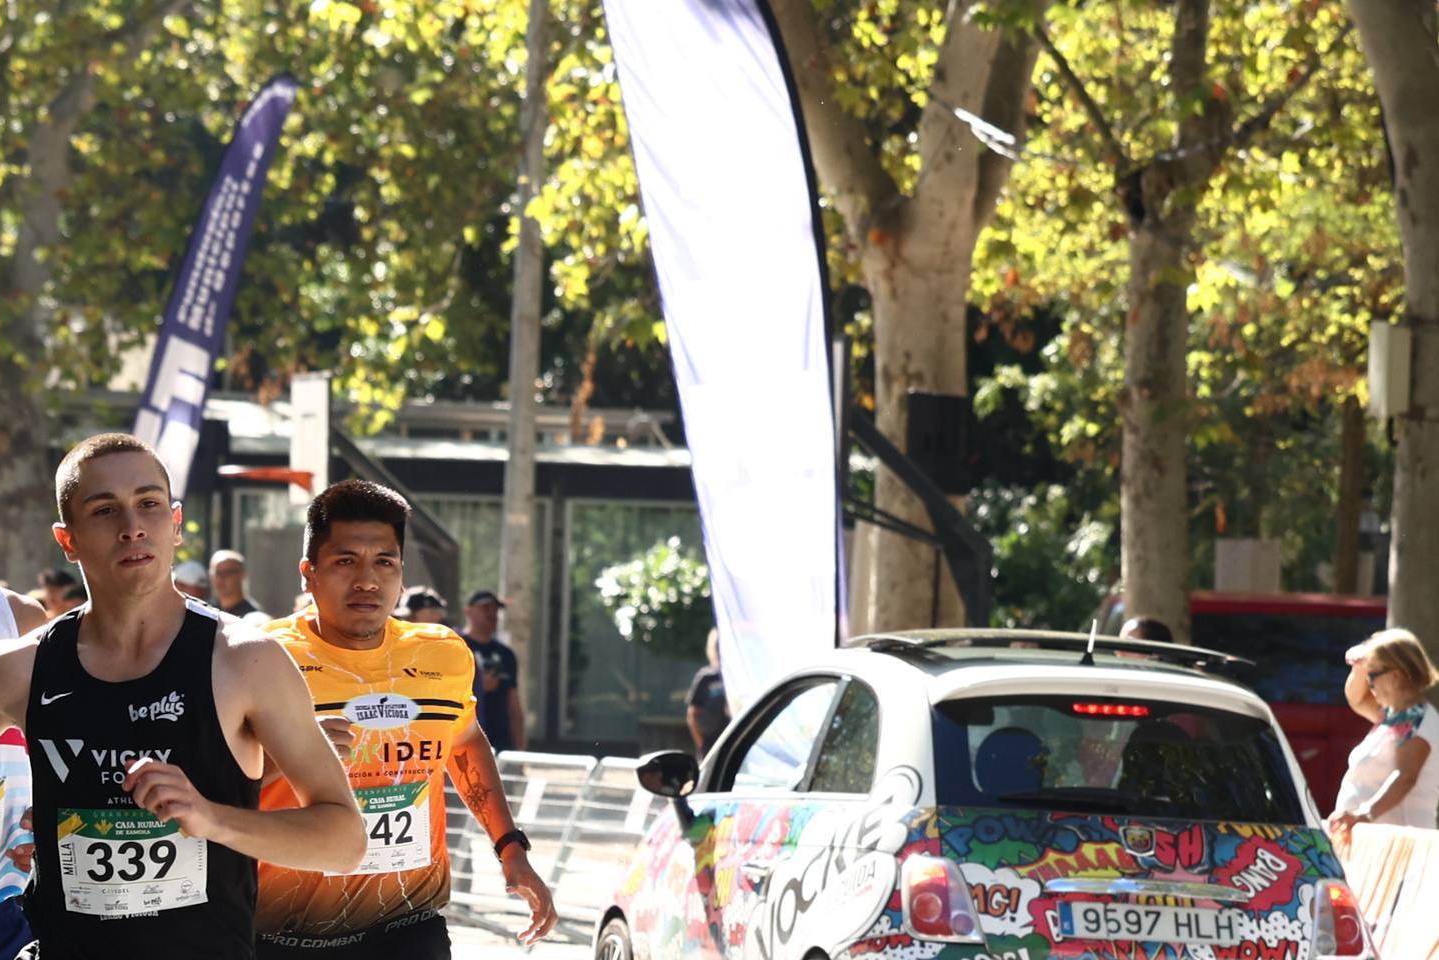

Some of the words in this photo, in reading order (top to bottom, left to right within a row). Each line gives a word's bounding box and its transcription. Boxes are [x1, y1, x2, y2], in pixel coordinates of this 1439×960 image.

[101, 771, 126, 785] FO
[137, 819, 166, 829] RURAL
[364, 811, 414, 846] 42
[61, 842, 74, 876] MILLA
[86, 840, 177, 883] 339
[300, 931, 367, 949] COMBAT
[1083, 908, 1161, 936] 9597
[1174, 912, 1235, 940] HLH
